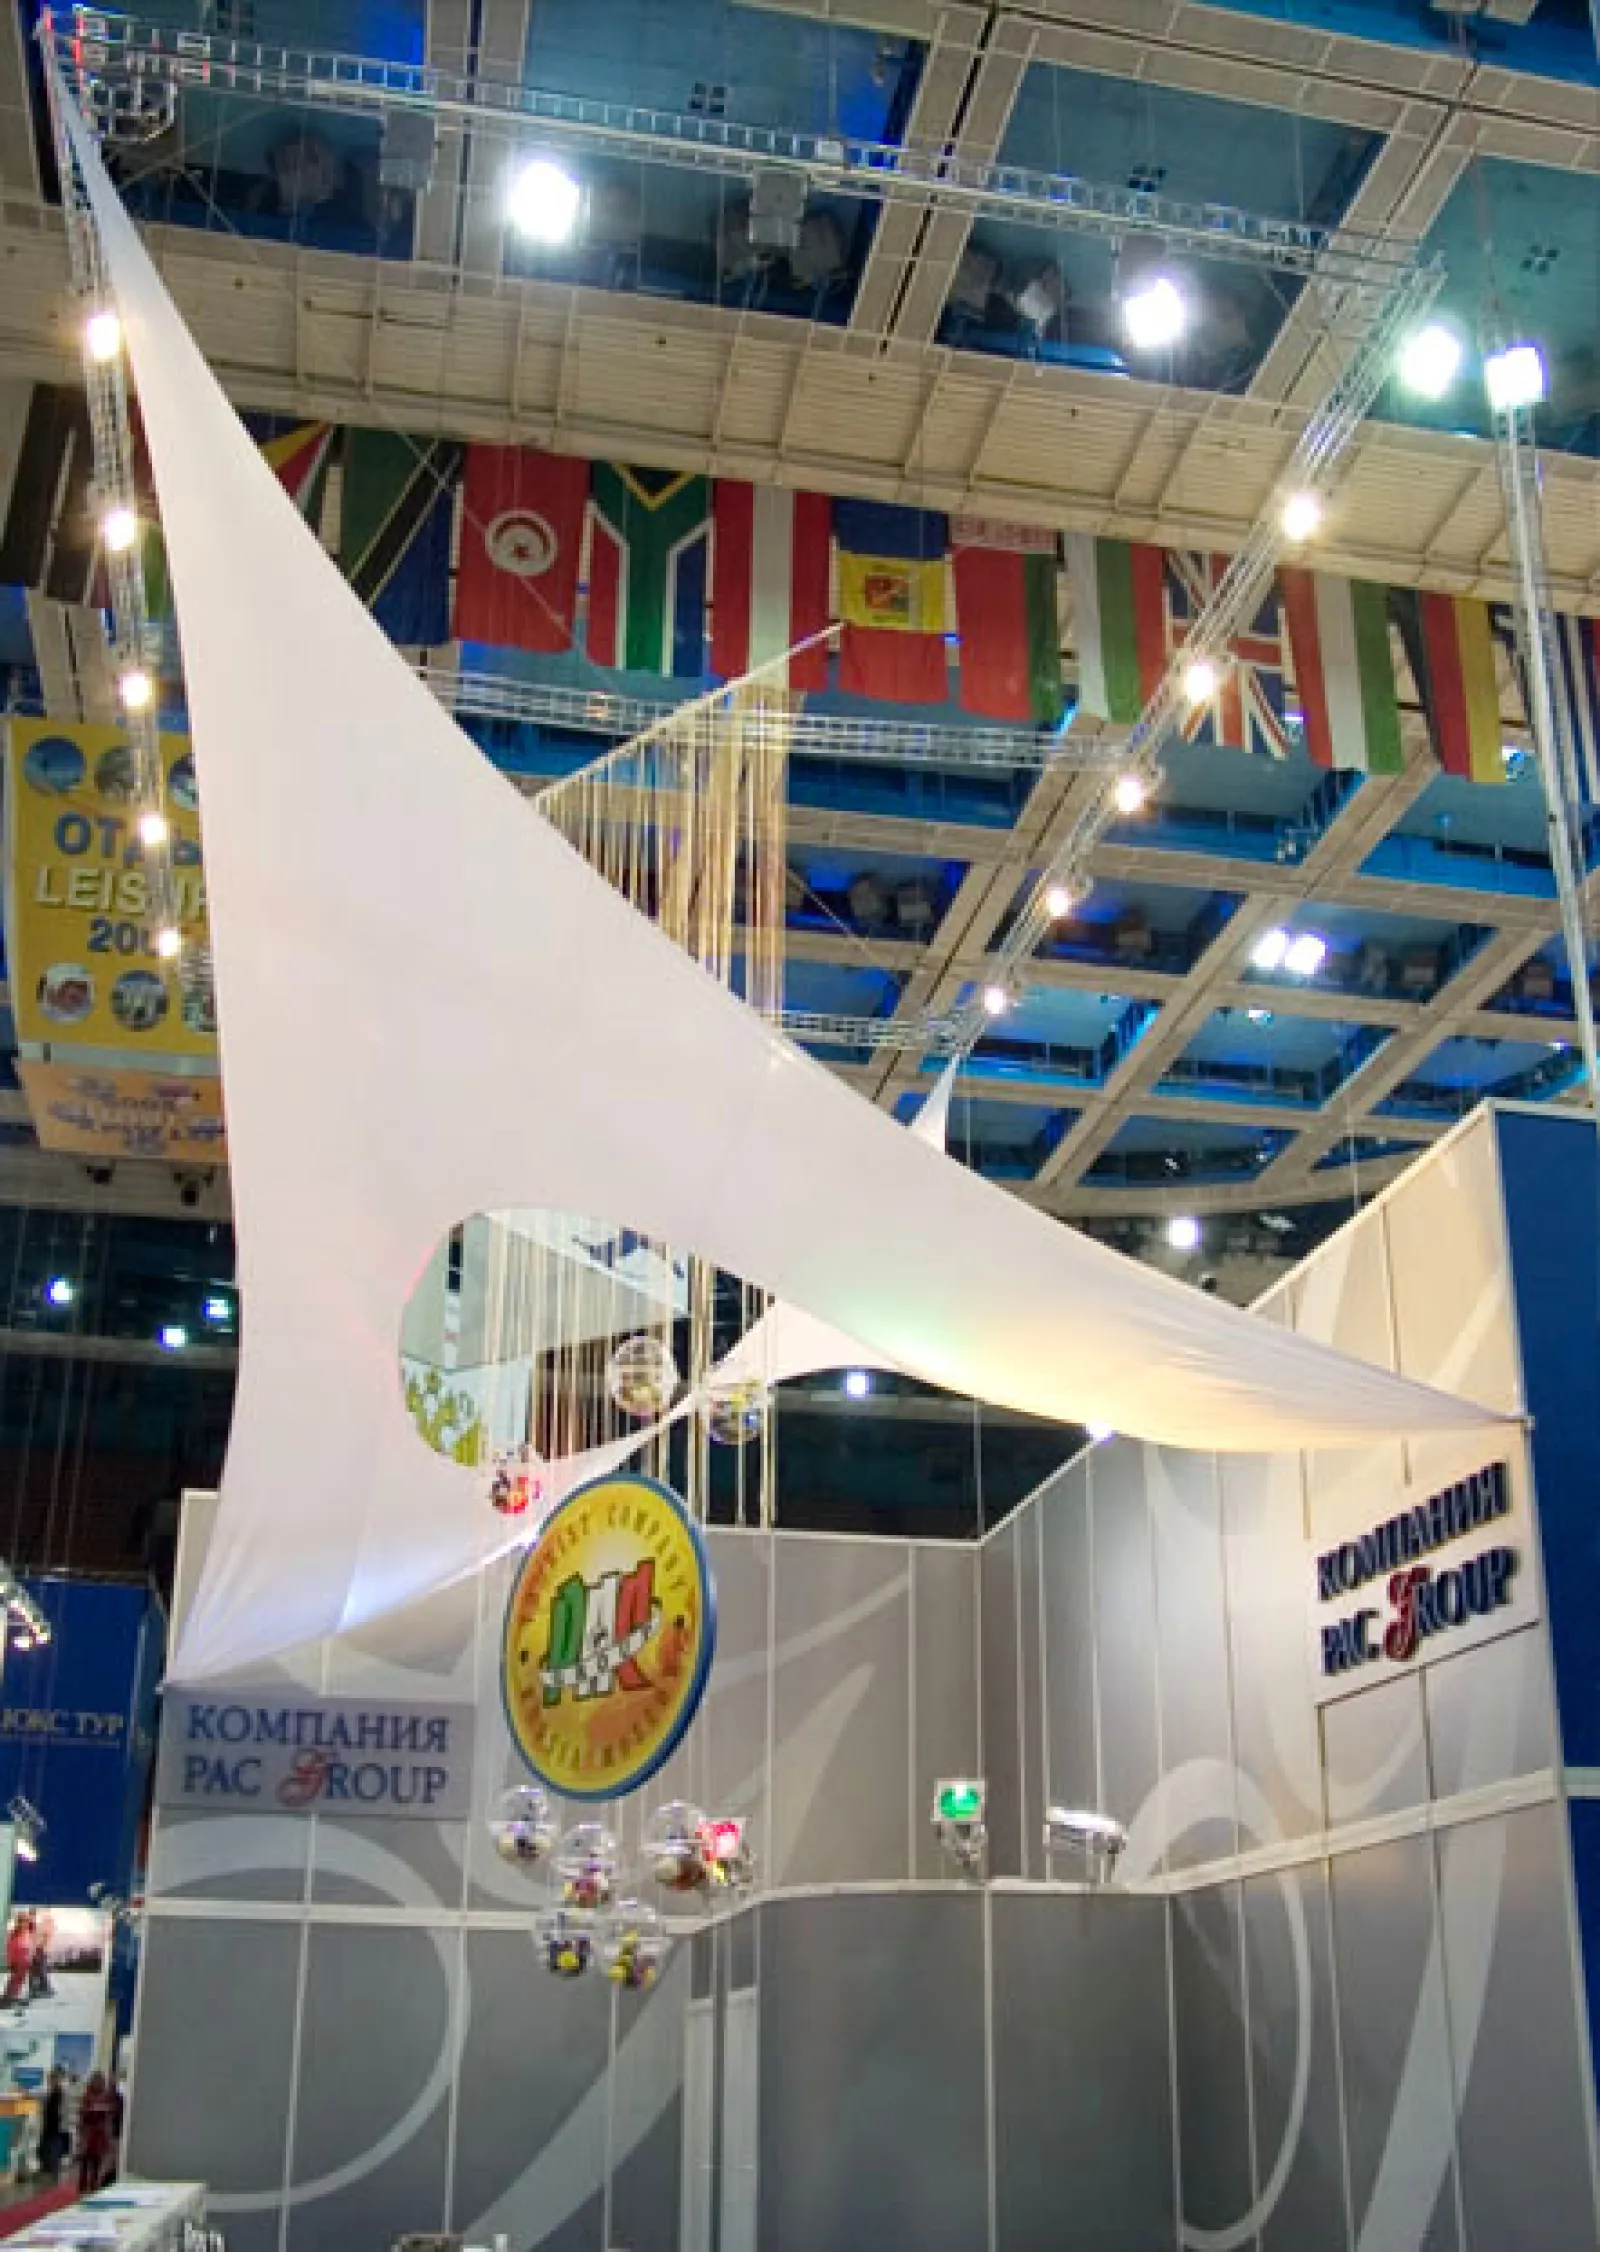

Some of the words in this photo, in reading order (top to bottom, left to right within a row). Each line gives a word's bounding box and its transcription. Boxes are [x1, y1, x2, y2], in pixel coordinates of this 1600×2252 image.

[1317, 1460, 1512, 1602] КОМПАНИЯ
[1320, 1607, 1382, 1678] PAC
[1385, 1547, 1520, 1661] GROUP
[185, 1703, 451, 1754] КОМПАНИЯ
[181, 1754, 263, 1798] PAC
[275, 1747, 449, 1808] GROUP
